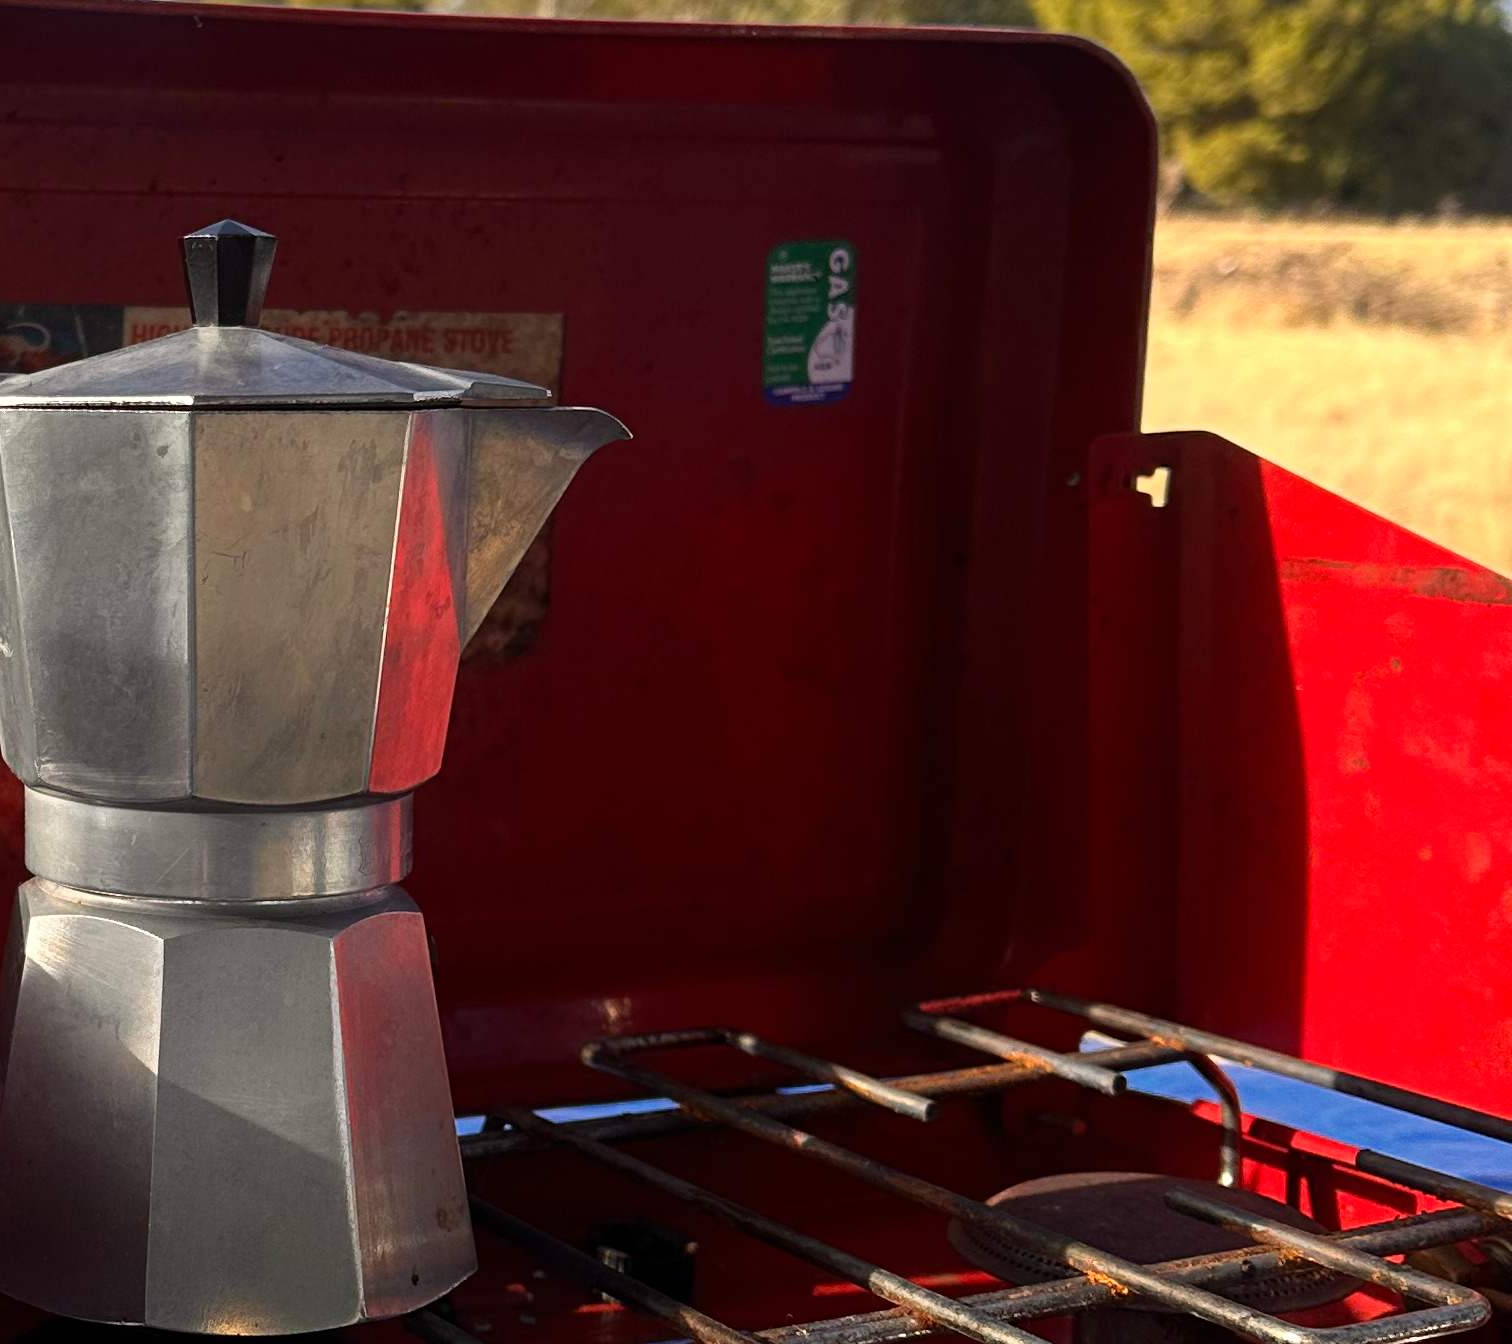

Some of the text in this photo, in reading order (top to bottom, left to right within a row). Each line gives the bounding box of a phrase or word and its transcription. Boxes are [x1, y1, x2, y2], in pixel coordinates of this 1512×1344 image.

[827, 247, 850, 322] GAS
[328, 327, 434, 354] PROPANE
[444, 328, 513, 355] STOVE
